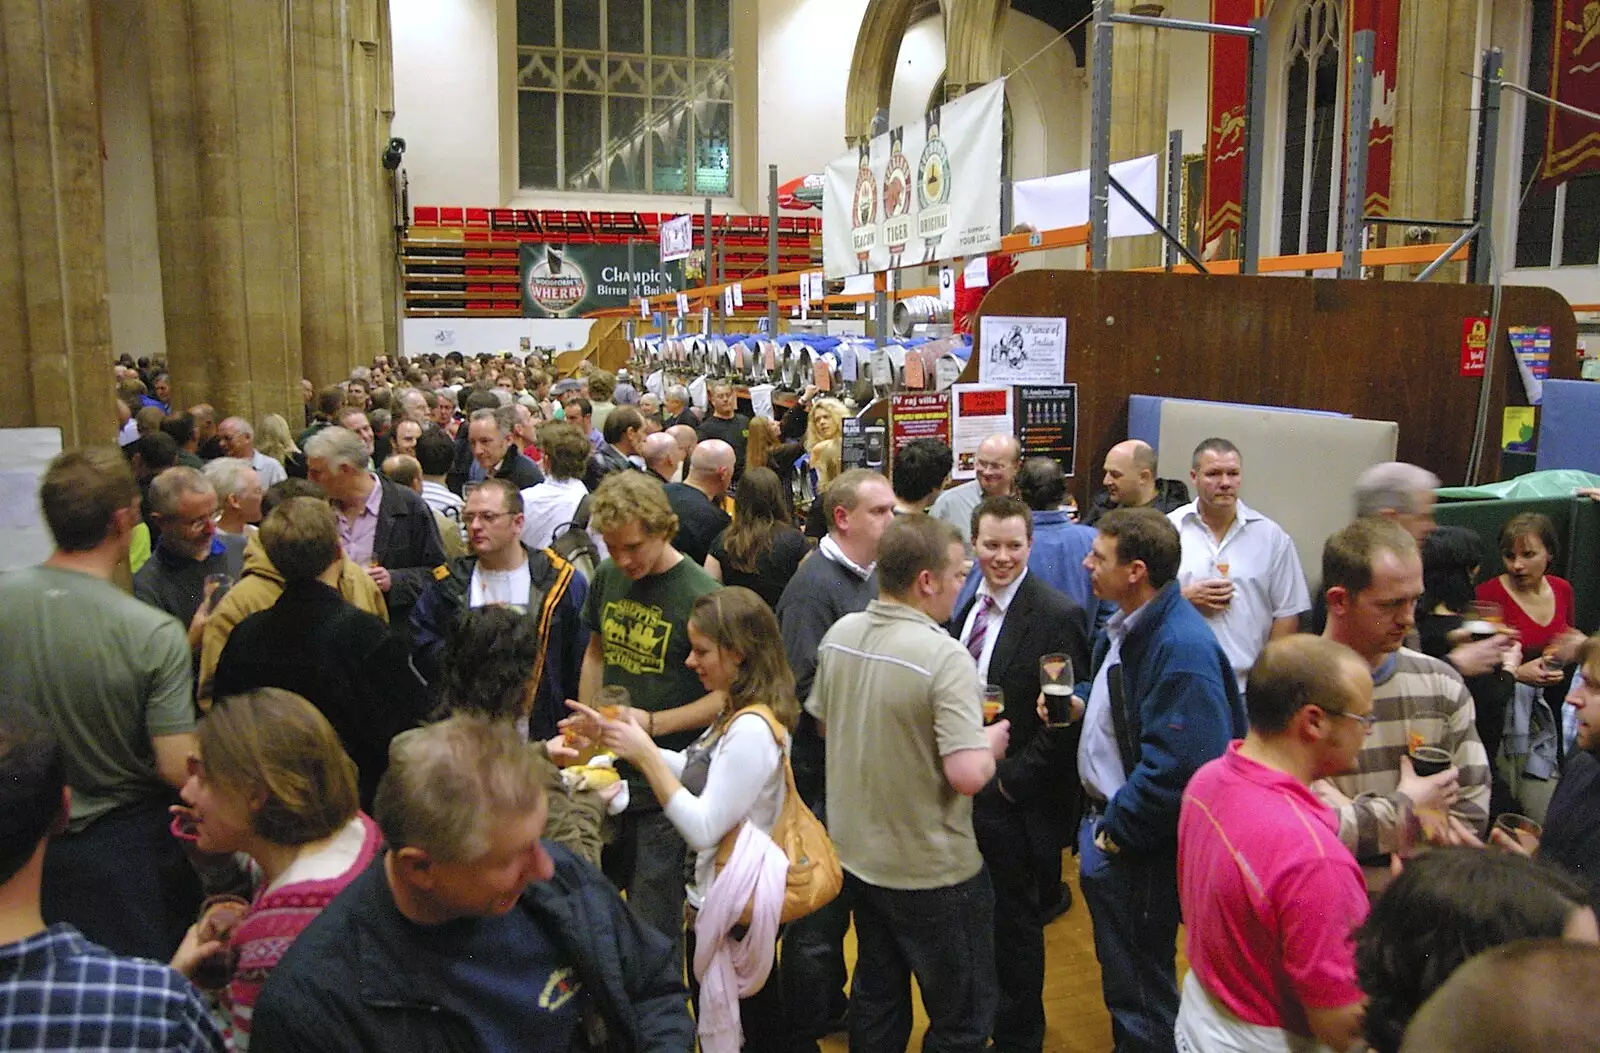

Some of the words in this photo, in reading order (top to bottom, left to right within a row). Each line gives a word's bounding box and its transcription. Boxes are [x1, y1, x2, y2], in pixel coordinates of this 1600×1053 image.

[920, 213, 948, 233] ORIGINAL
[887, 223, 908, 242] TIGER
[960, 237, 975, 245] YOUR
[977, 234, 991, 242] LOCAL
[854, 232, 875, 249] BEACON
[531, 285, 583, 299] WHERRY
[904, 397, 917, 407] raj
[919, 396, 937, 405] villa
